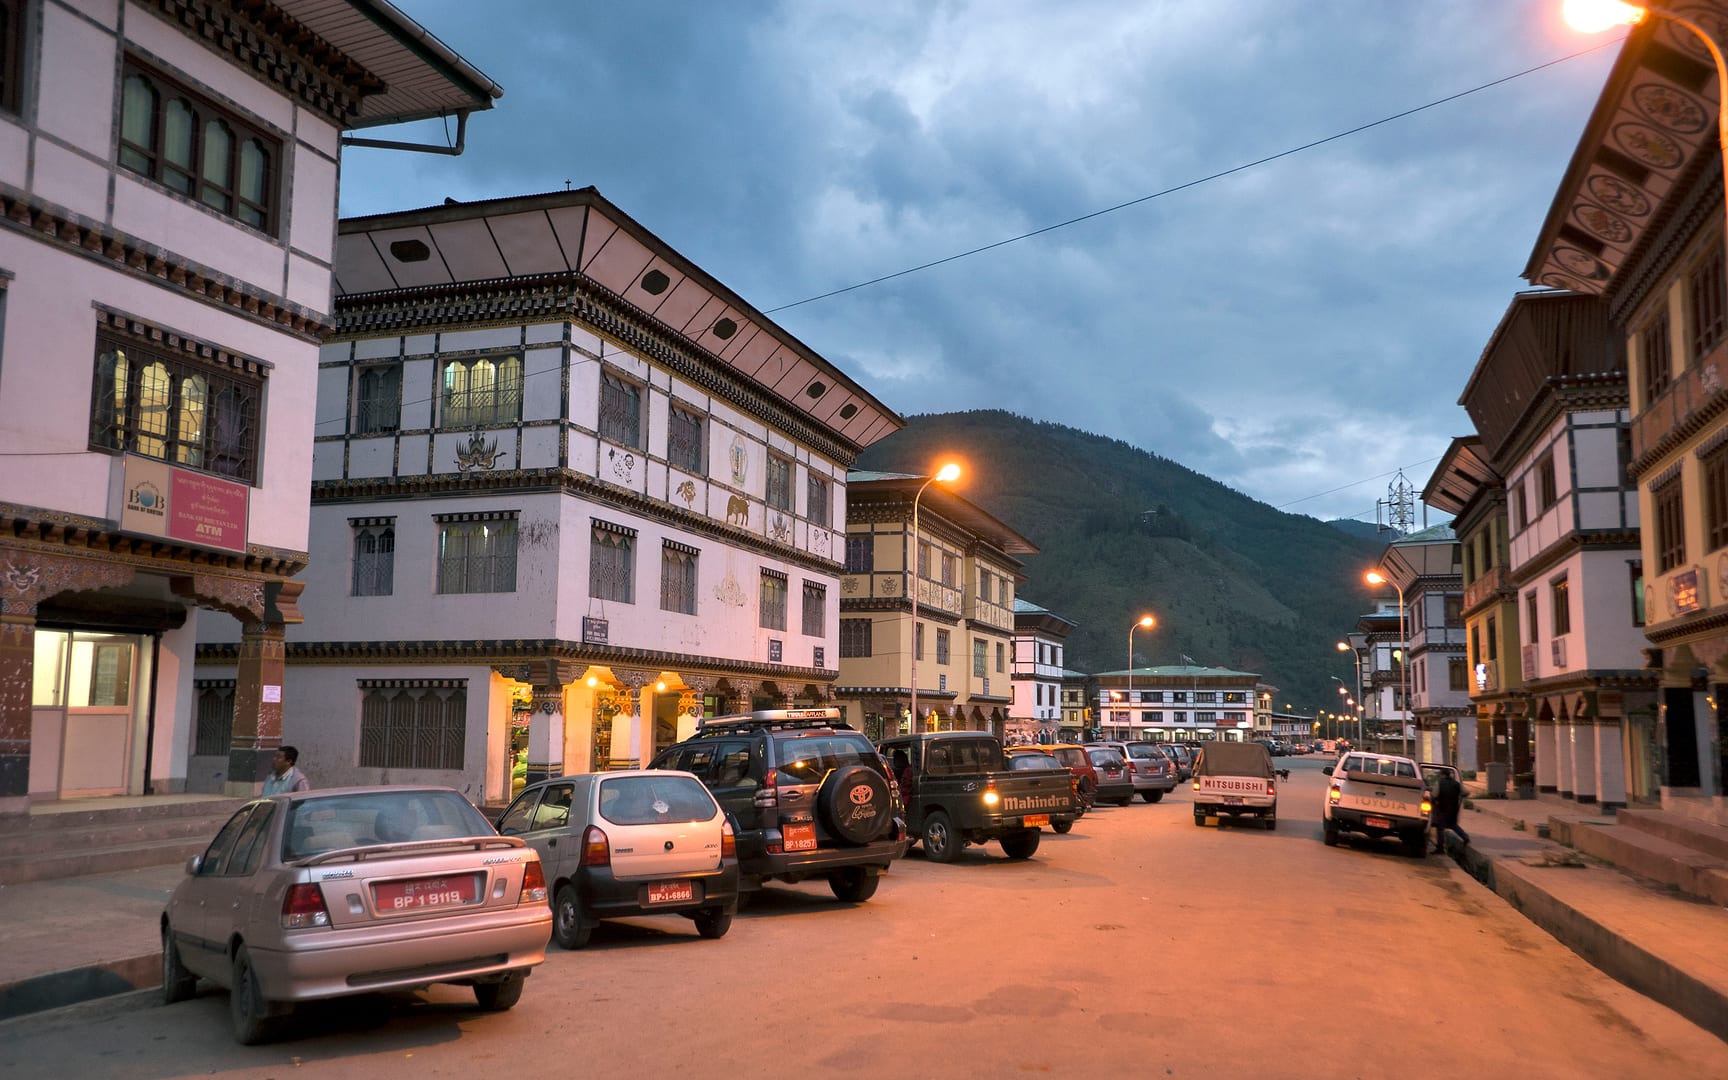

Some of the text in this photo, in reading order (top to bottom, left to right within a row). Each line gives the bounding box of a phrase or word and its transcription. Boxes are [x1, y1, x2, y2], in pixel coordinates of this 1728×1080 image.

[195, 523, 222, 537] ATM
[1204, 780, 1263, 791] MITSUBISHI
[1354, 797, 1407, 811] TOYOTA
[394, 896, 414, 909] BP
